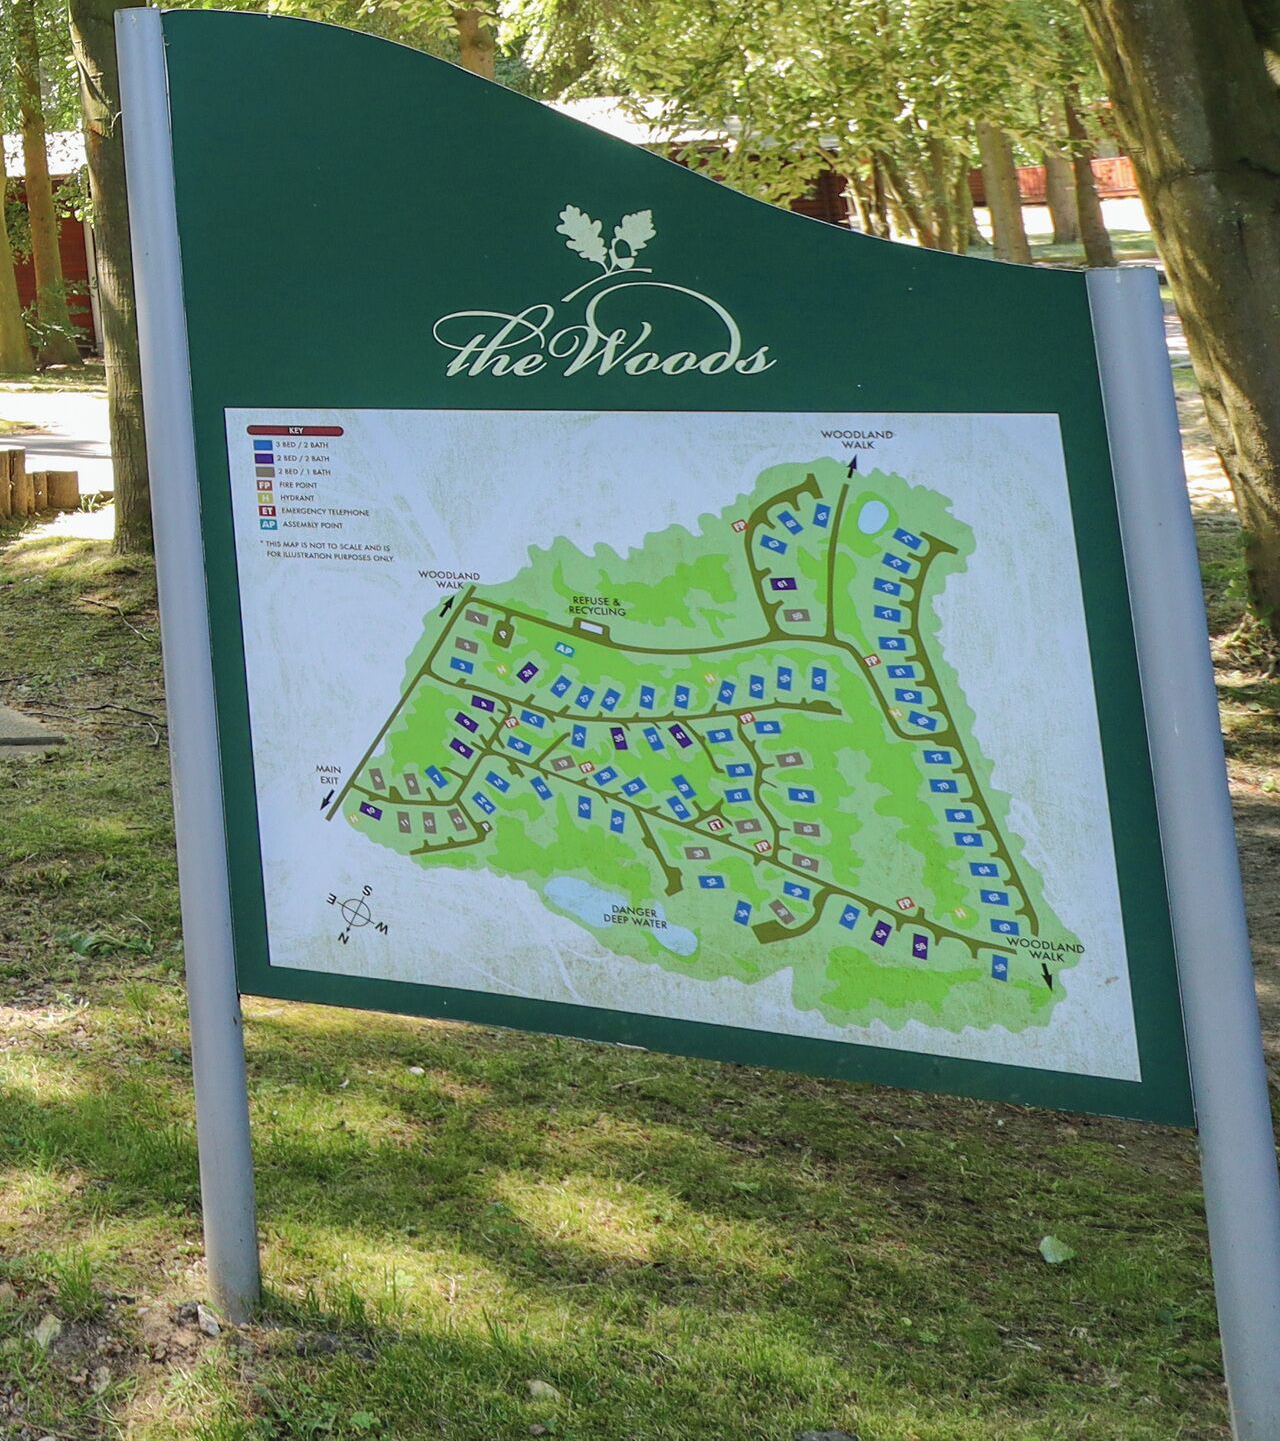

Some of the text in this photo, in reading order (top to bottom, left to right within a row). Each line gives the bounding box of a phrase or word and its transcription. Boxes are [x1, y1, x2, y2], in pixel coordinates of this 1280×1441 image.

[432, 282, 777, 377] the Woods
[821, 430, 893, 439] WOODLAND
[842, 441, 875, 449] WALK
[733, 521, 746, 531] FP
[418, 570, 480, 580] WOODLAND
[436, 581, 464, 589] WALK
[573, 596, 620, 606] REFUSE &
[569, 606, 626, 617] RECYCLING
[499, 630, 506, 639] P
[557, 644, 572, 655] AP
[865, 656, 877, 666] FP
[522, 669, 533, 678] 24
[580, 694, 589, 703] 27
[506, 718, 516, 726] FP
[740, 714, 752, 723] FP
[574, 732, 584, 741] 21
[614, 734, 624, 742] 35
[648, 734, 657, 743] 37
[316, 765, 341, 774] MAIN
[581, 763, 591, 772] FP
[321, 776, 338, 785] EXIT
[425, 819, 433, 827] 12
[708, 820, 721, 830] ET
[756, 842, 768, 852] FP
[362, 885, 372, 896] S
[899, 899, 911, 908] FP
[612, 905, 657, 917] DANGER
[604, 914, 667, 929] DEEP WATER
[338, 932, 349, 944] N
[1006, 937, 1085, 953] WOODLAND
[1029, 950, 1064, 962] WALK
